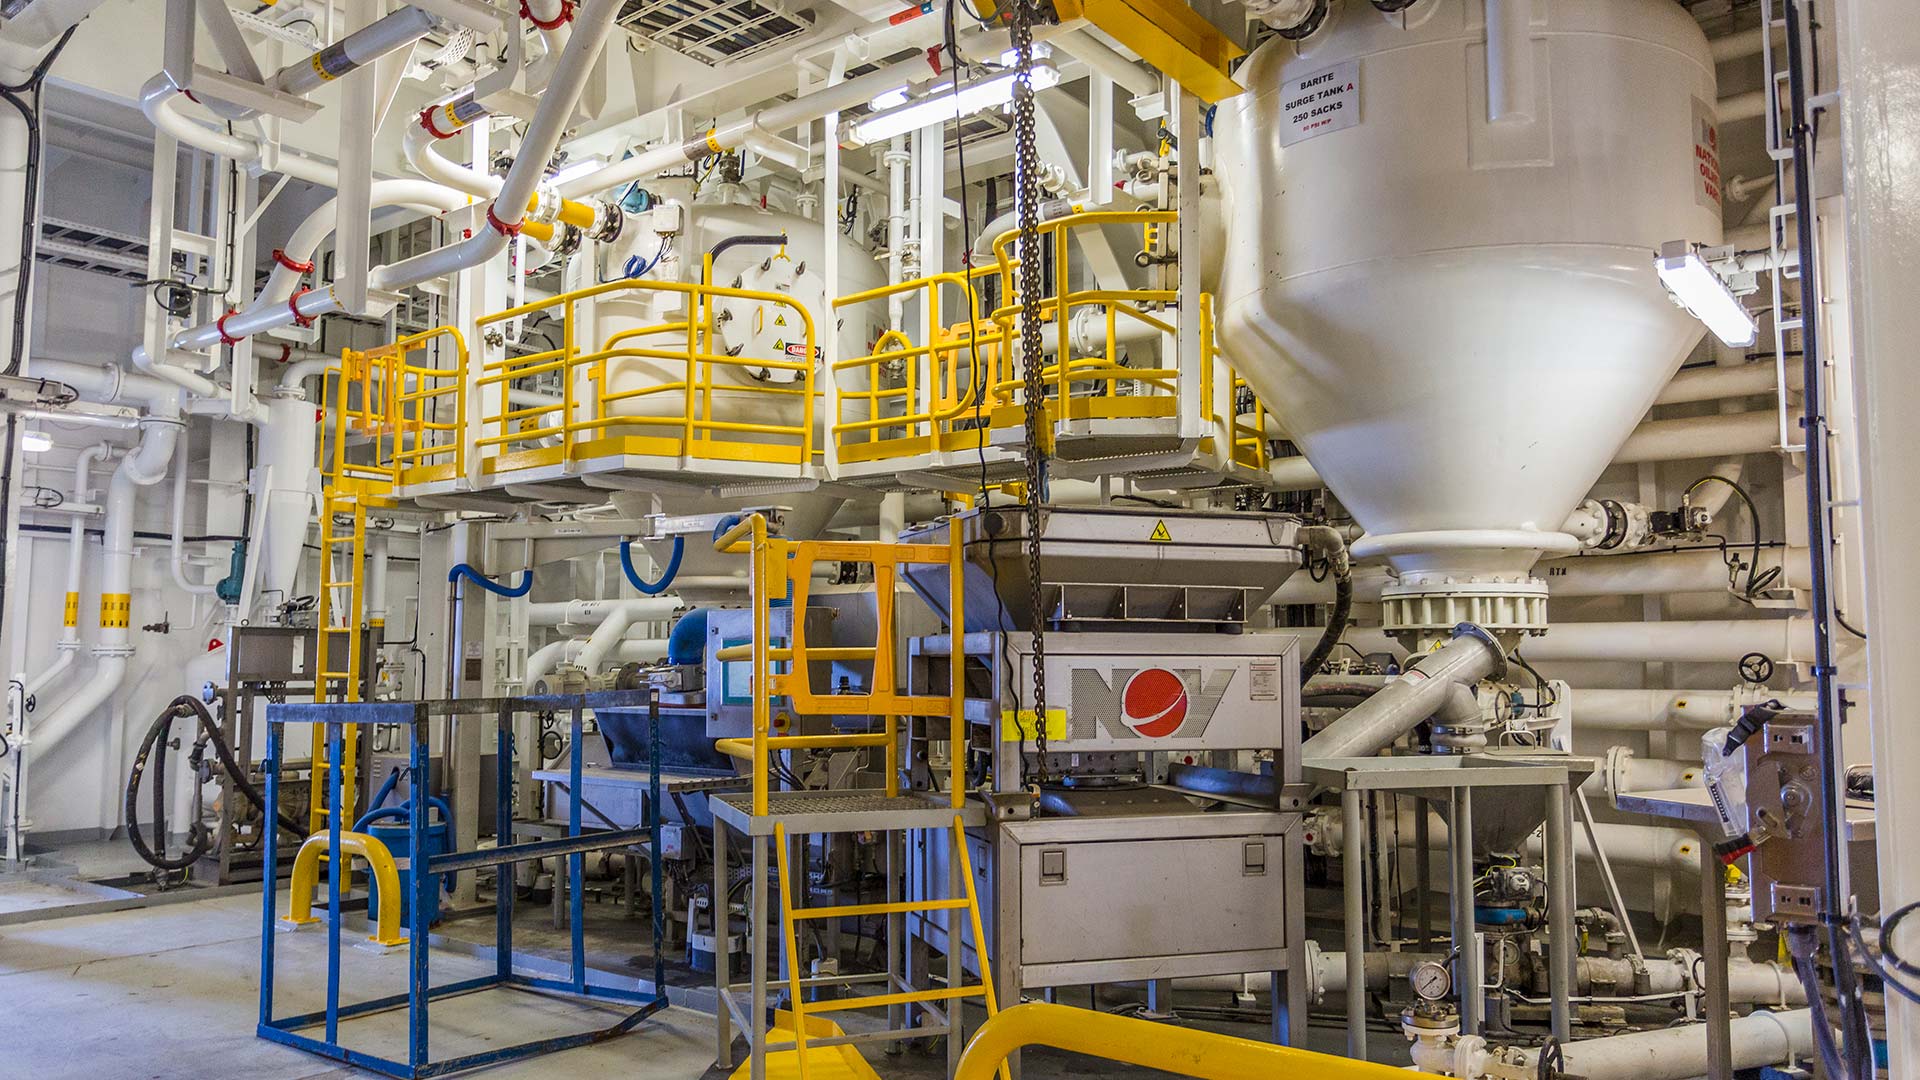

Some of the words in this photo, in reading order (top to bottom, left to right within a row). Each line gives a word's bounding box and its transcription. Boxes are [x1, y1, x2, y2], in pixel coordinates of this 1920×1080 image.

[1300, 72, 1334, 89] BARITE
[1285, 94, 1315, 111] SURGE
[1316, 85, 1344, 100] TANK
[1347, 83, 1354, 91] A
[1293, 112, 1308, 124] 250
[1310, 101, 1343, 117] SACKS
